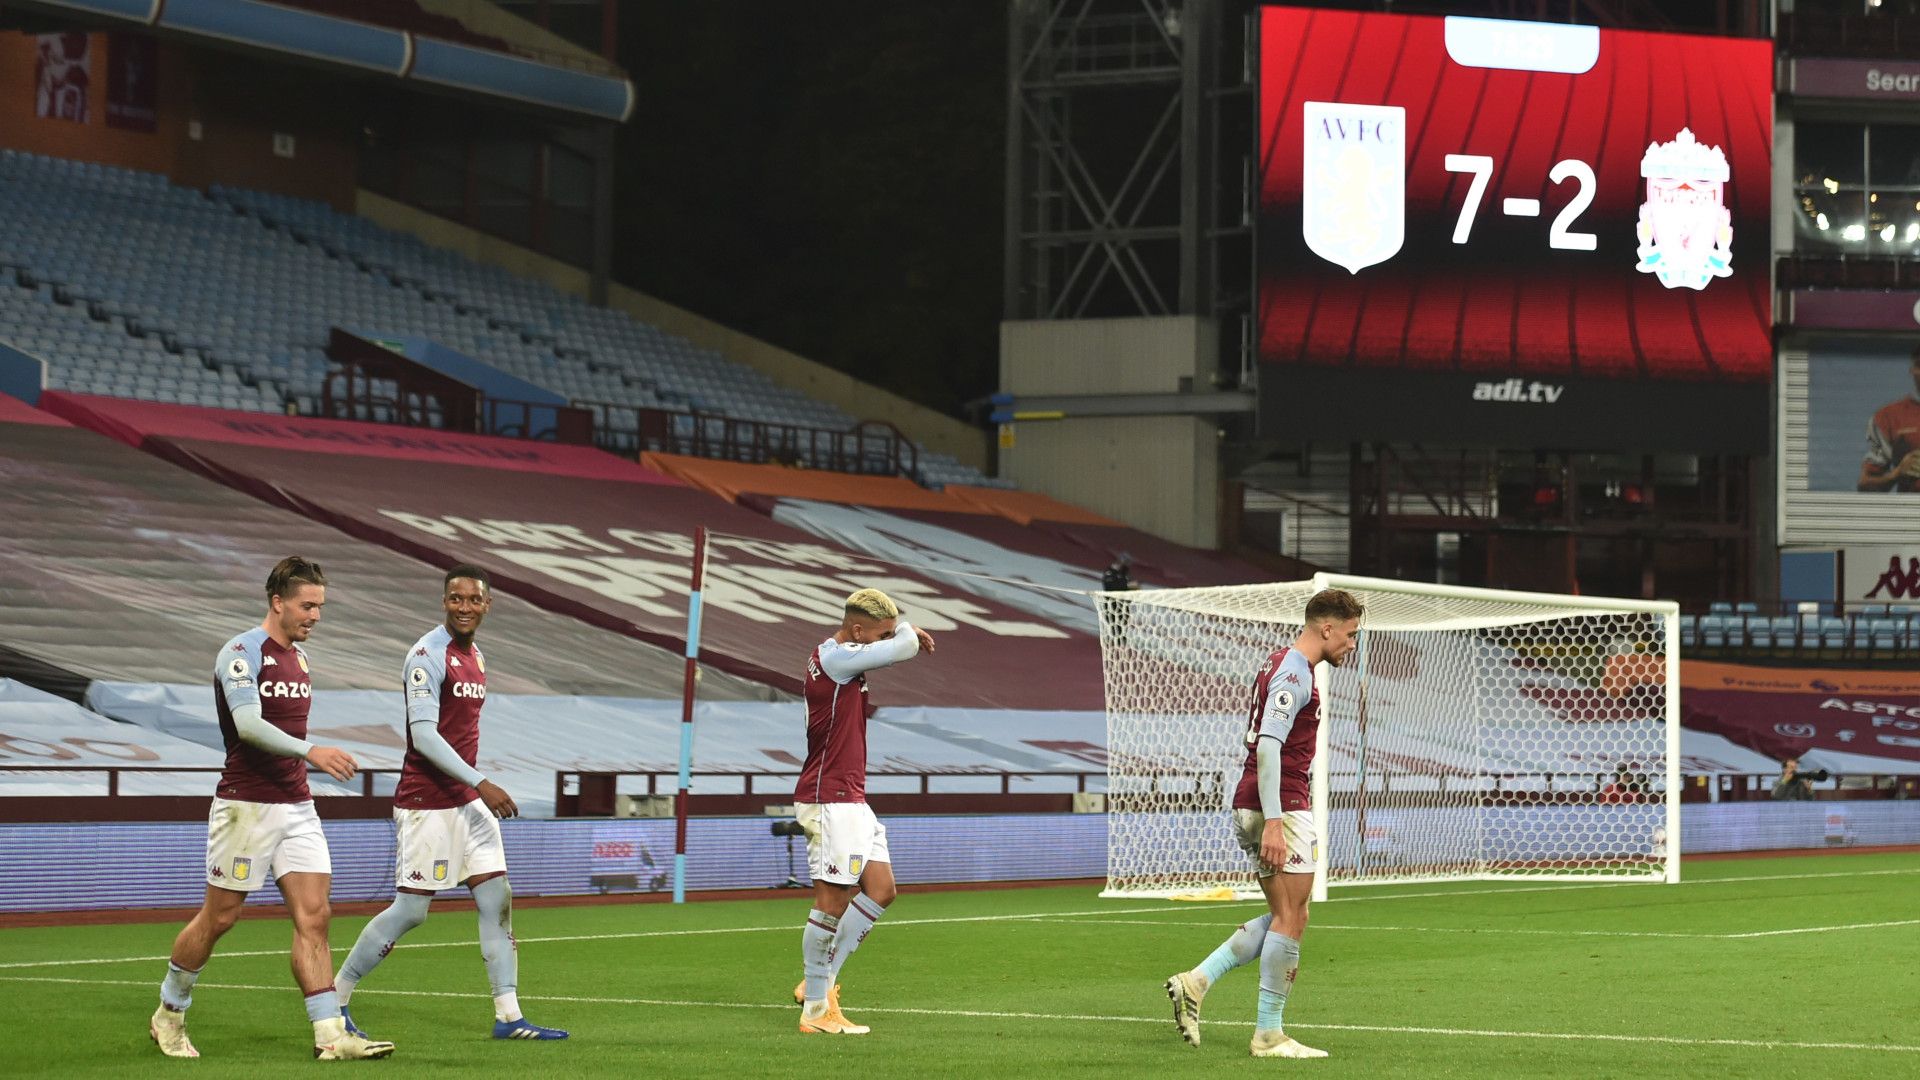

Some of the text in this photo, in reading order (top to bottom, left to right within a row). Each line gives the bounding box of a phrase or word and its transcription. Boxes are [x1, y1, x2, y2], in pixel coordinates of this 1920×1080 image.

[1866, 69, 1920, 92] Sear
[1316, 118, 1394, 144] AVFC
[1445, 154, 1597, 250] 7-2
[1472, 378, 1564, 403] adi.tv
[376, 508, 624, 553] PART
[260, 681, 311, 698] CAZO
[453, 681, 486, 698] CAZO
